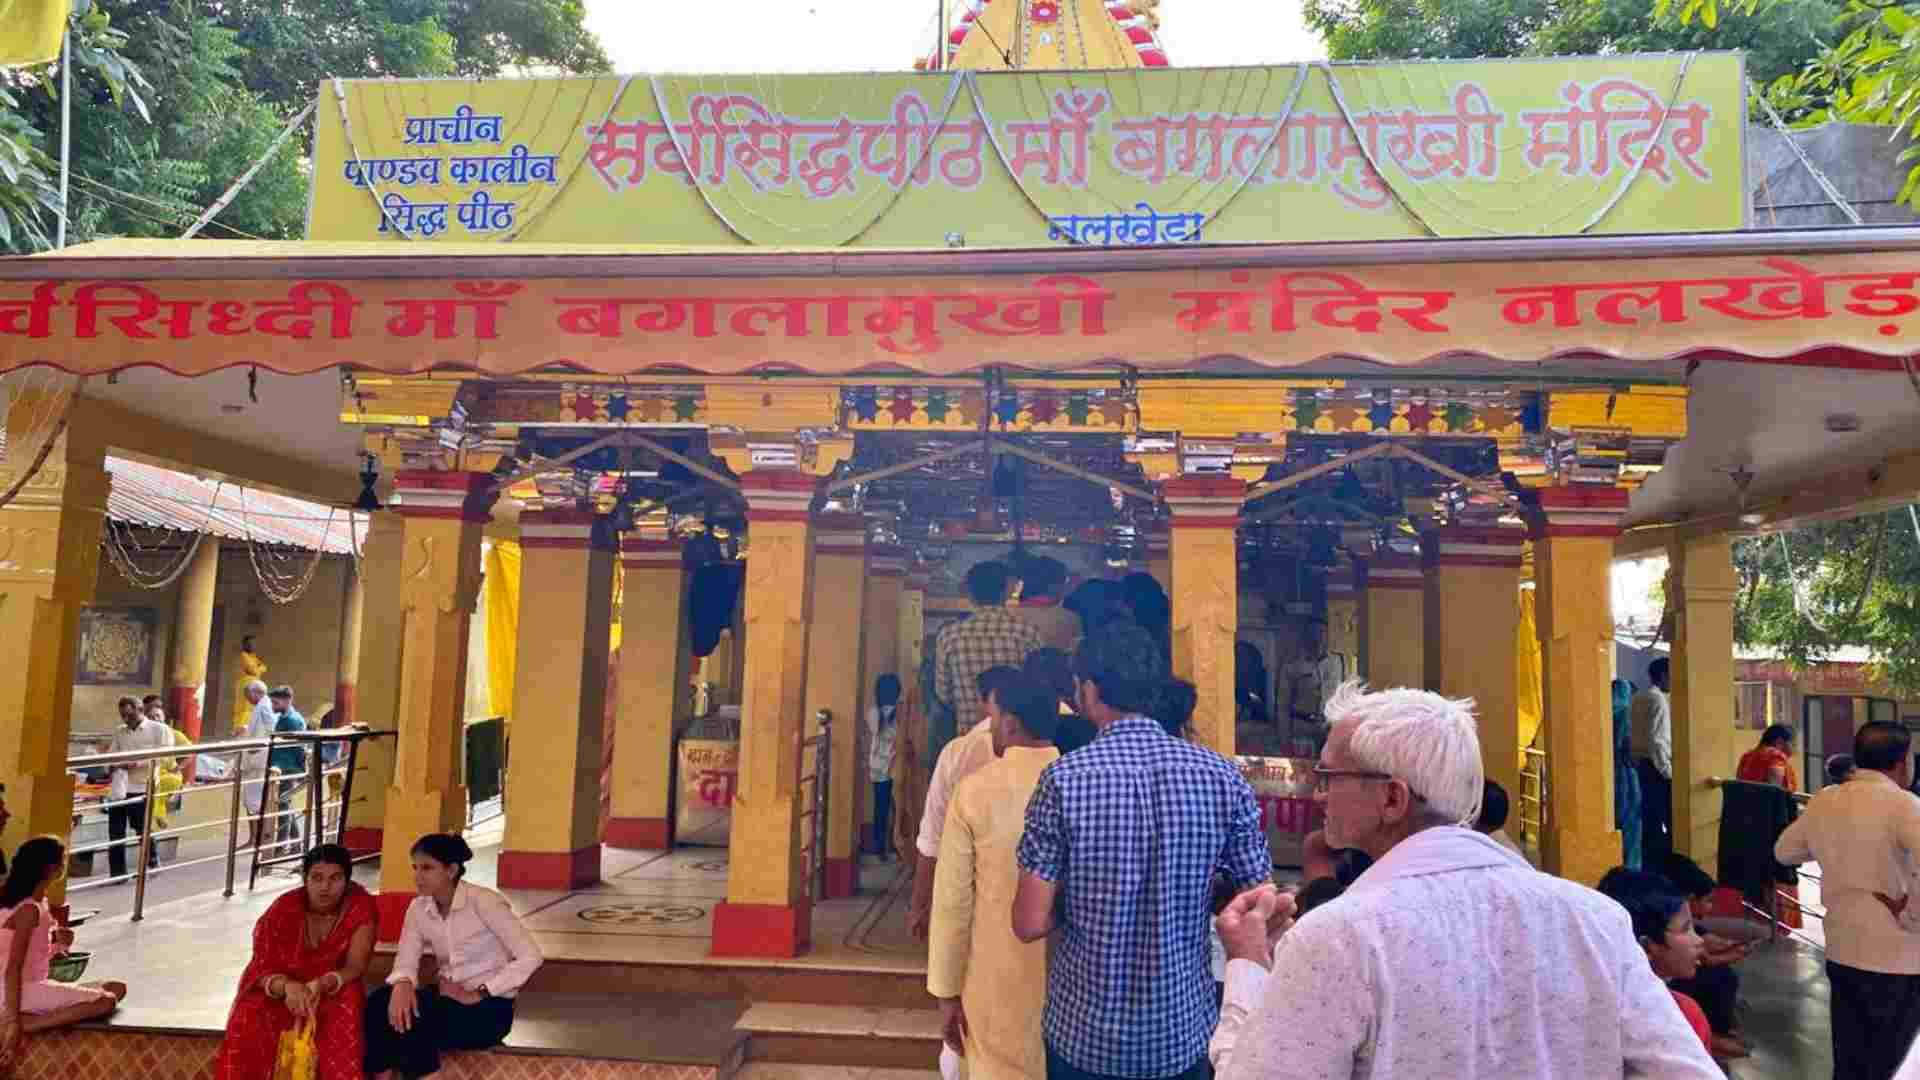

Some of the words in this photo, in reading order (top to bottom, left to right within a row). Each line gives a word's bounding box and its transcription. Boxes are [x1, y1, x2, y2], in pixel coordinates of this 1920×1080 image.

[404, 104, 504, 144] प्राचीन
[1006, 93, 1109, 185] माँ
[1112, 85, 1501, 209] बगलामुखी
[1520, 79, 1711, 181] मंदिर
[344, 157, 443, 186] पाण्डव
[449, 144, 560, 184] कालीन
[378, 192, 449, 236] सिद्ध
[456, 191, 516, 231] पीठ
[0, 279, 362, 339] र्वसिध्दी
[384, 280, 527, 339] माँ
[554, 273, 1117, 354] बगलामुखी
[1171, 271, 1457, 333] मंदिर
[1495, 256, 1920, 337] नलखेड़
